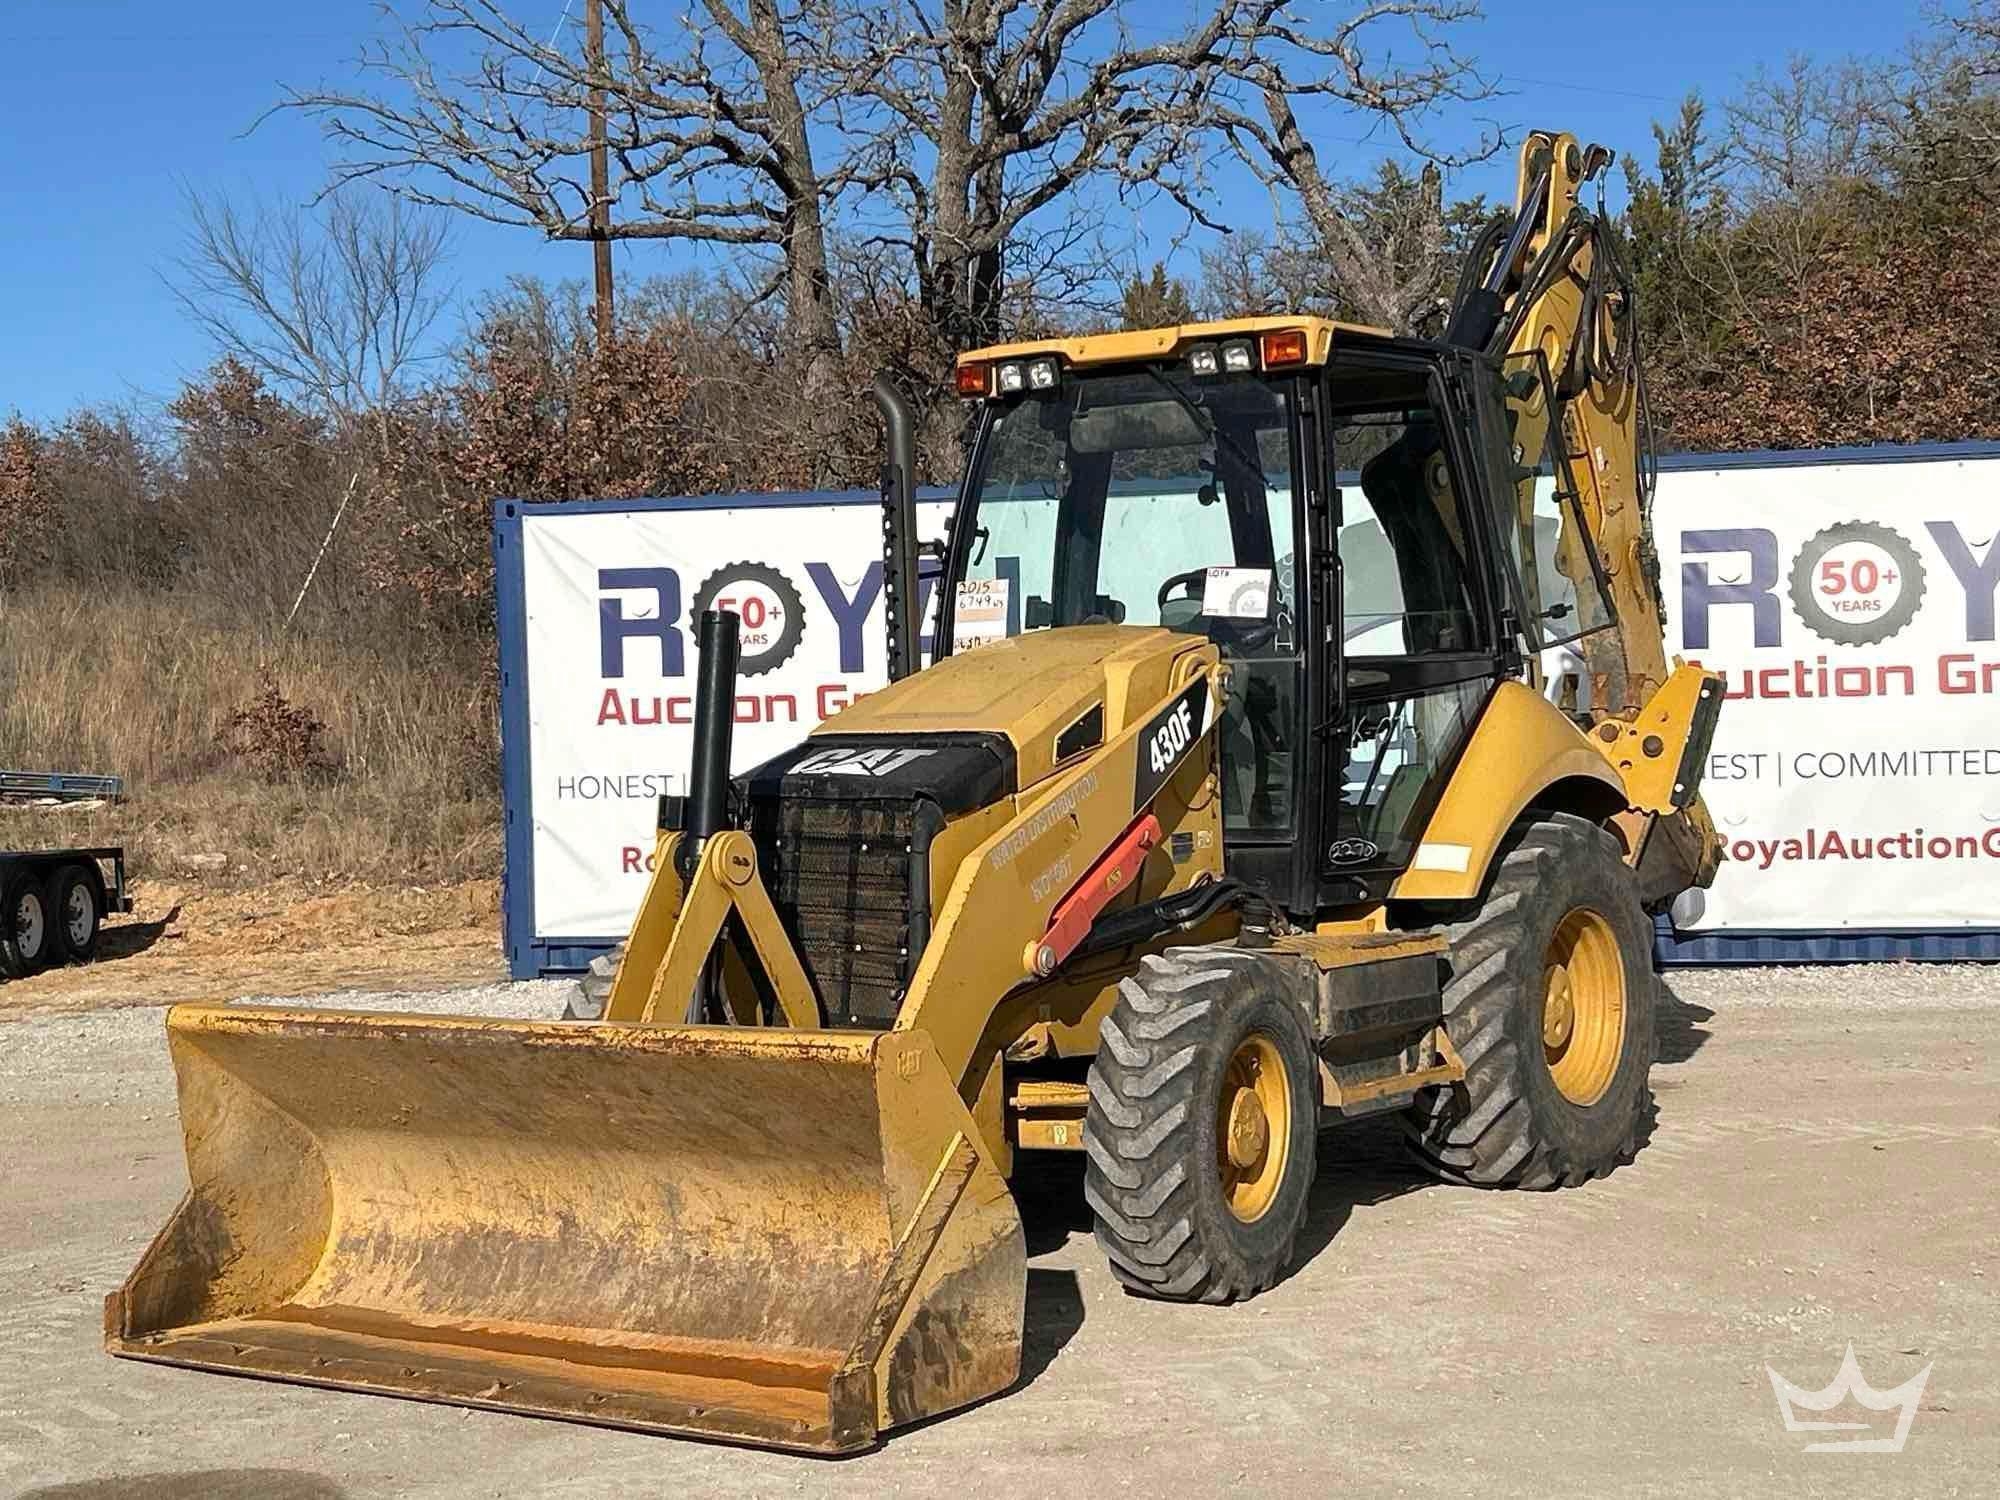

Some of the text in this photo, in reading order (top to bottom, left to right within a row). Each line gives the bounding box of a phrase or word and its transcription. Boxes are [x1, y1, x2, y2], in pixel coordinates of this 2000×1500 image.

[959, 582, 990, 595] 2015
[1820, 560, 1898, 595] 50+
[1832, 600, 1881, 612] YEARS
[741, 633, 769, 645] ARS
[1687, 655, 1914, 699] uction
[597, 688, 796, 725] Aucon
[1150, 699, 1192, 773] 430F
[787, 749, 938, 776] CAT
[1703, 750, 2000, 780] EST COMMITTED
[558, 775, 674, 799] HONEST
